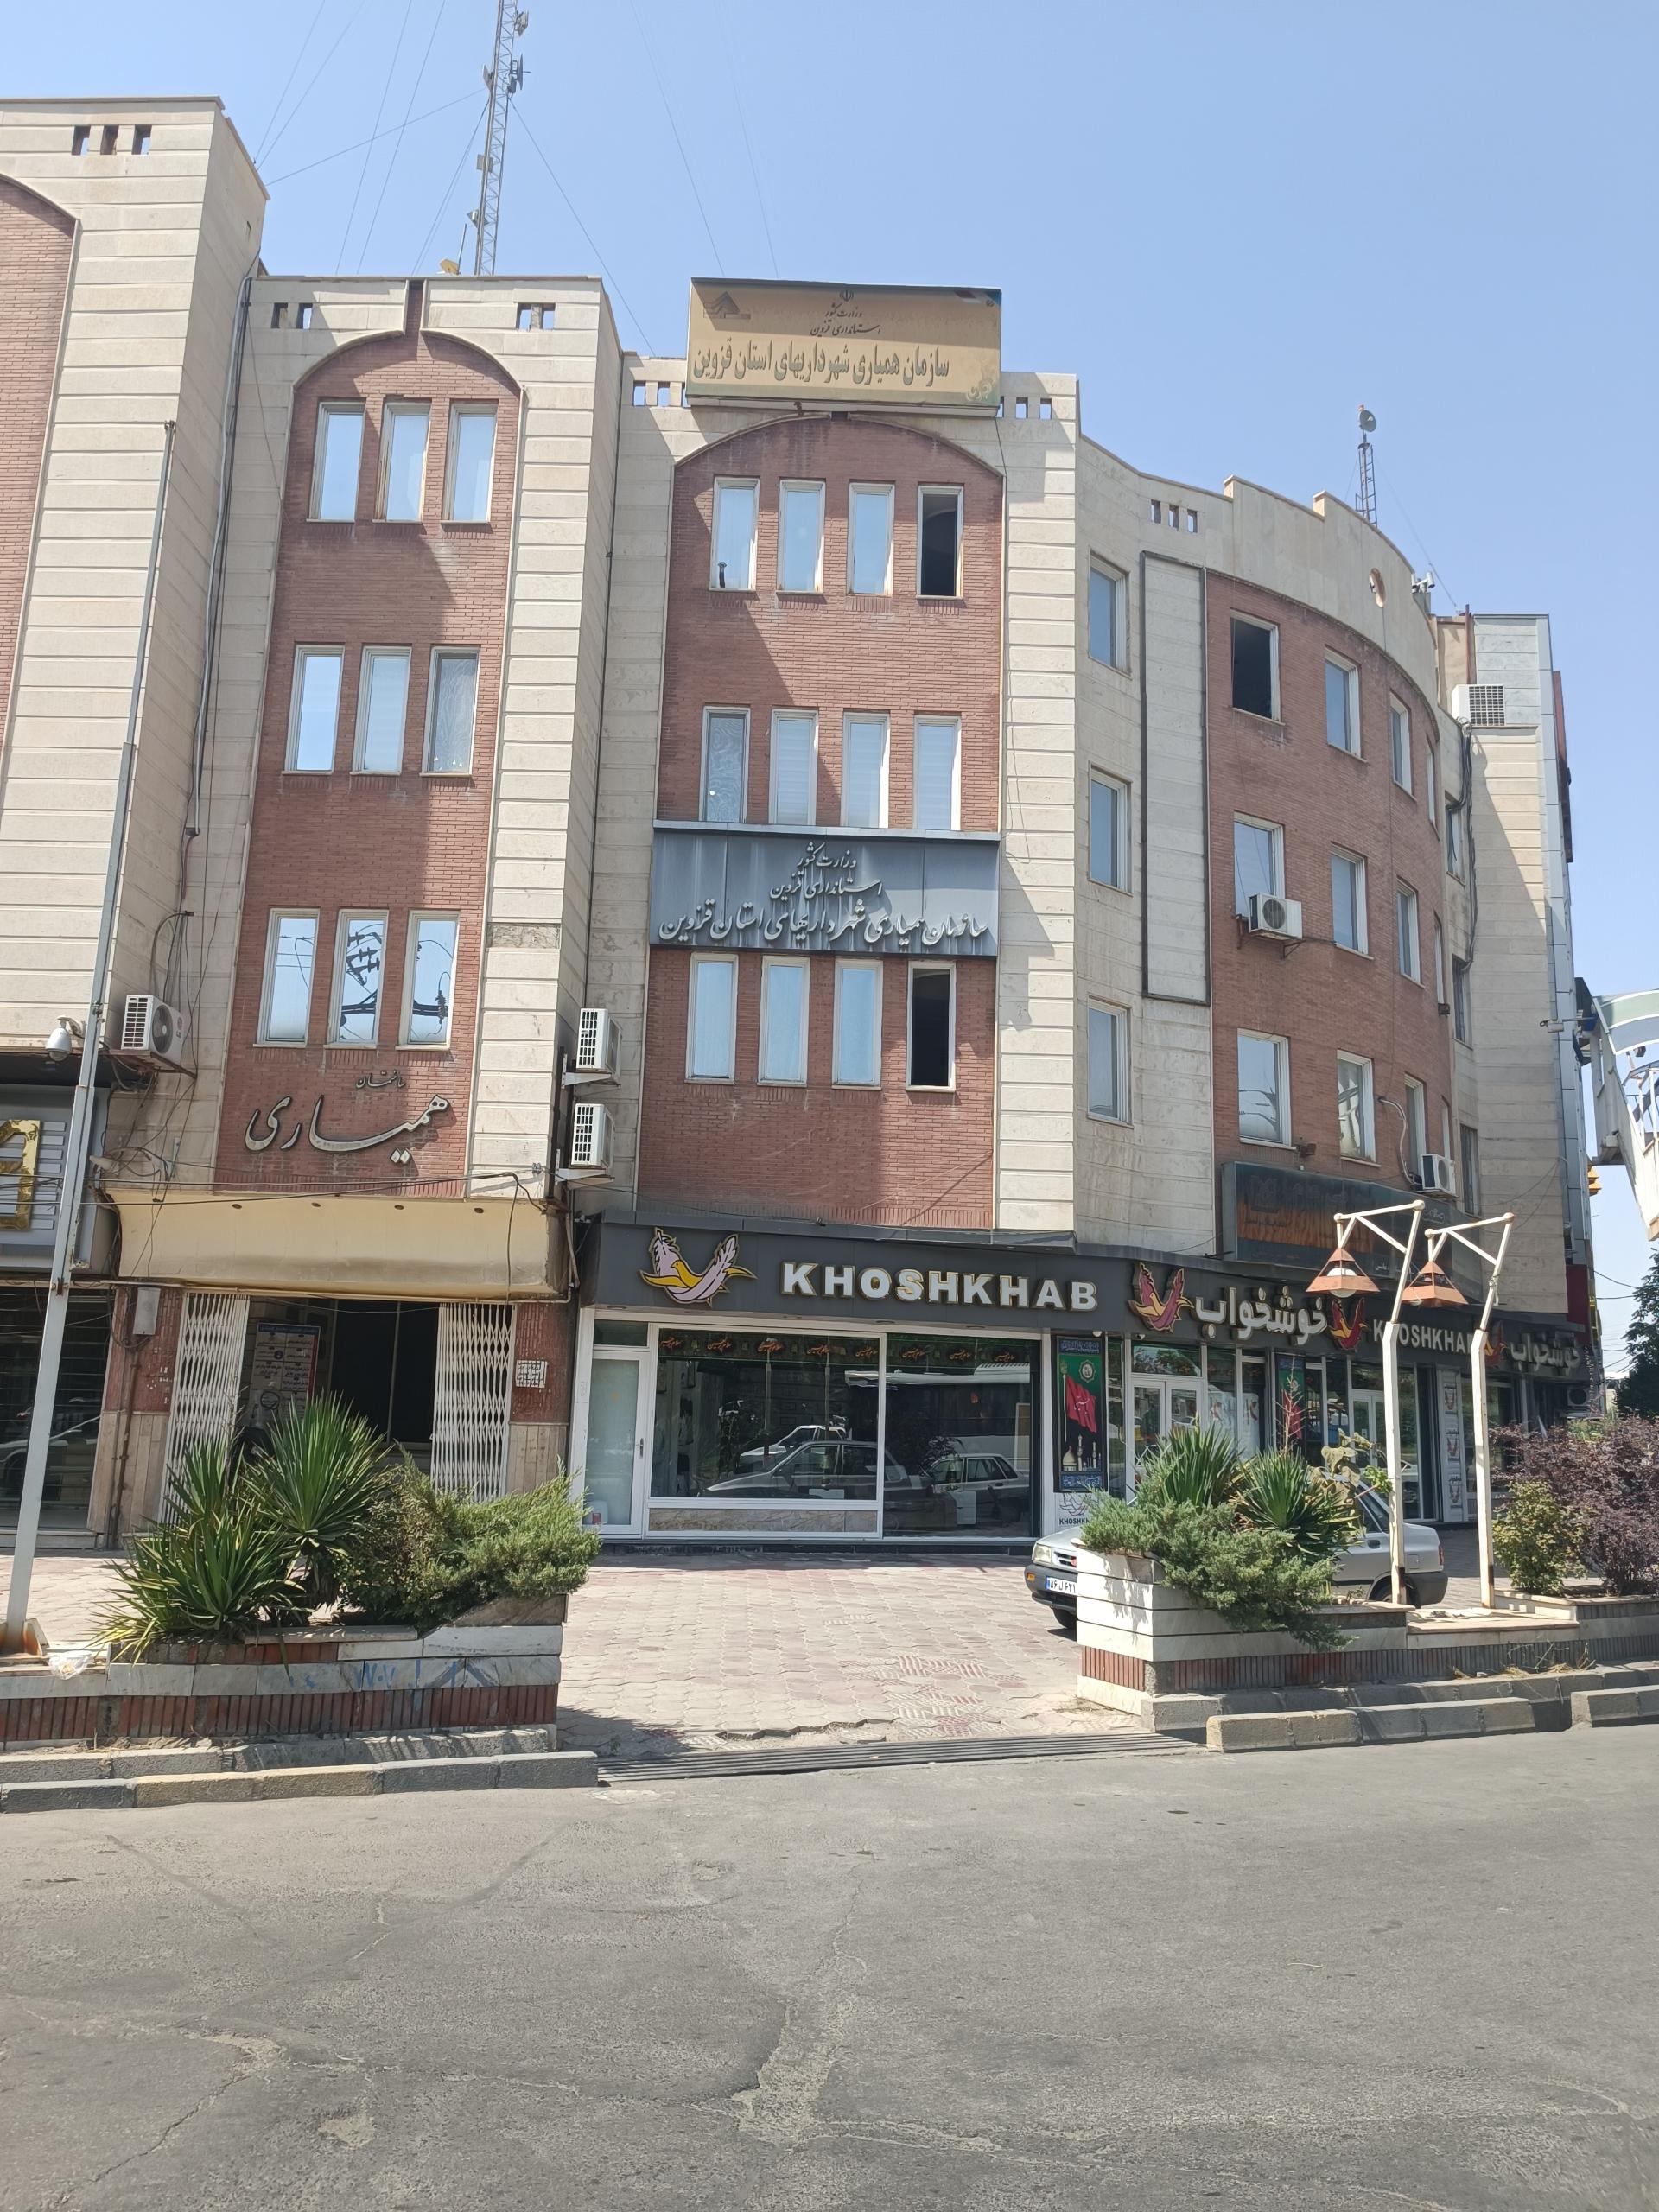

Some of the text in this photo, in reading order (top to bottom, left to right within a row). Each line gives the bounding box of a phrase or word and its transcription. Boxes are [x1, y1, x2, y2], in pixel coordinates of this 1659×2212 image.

[810, 319, 881, 338] استانداری قزوین
[824, 302, 862, 318] وزارت کشور
[694, 336, 733, 379] قزوین
[734, 340, 772, 380] استان
[853, 344, 900, 385] همیاری
[903, 346, 949, 386] سازمان
[798, 842, 856, 868] وزارت کشور
[770, 871, 882, 900] استانداری قزوین
[658, 898, 715, 943] قزوین
[709, 902, 764, 941] استان
[865, 913, 924, 946] همیاری
[922, 912, 988, 946] سازمان
[355, 1070, 406, 1089] ساختمان
[245, 1095, 449, 1164] همیاری
[779, 1261, 1099, 1313] KHOSHKHAB
[1194, 1285, 1328, 1345] خوشخواب
[1373, 1319, 1472, 1355] KOSHKHA
